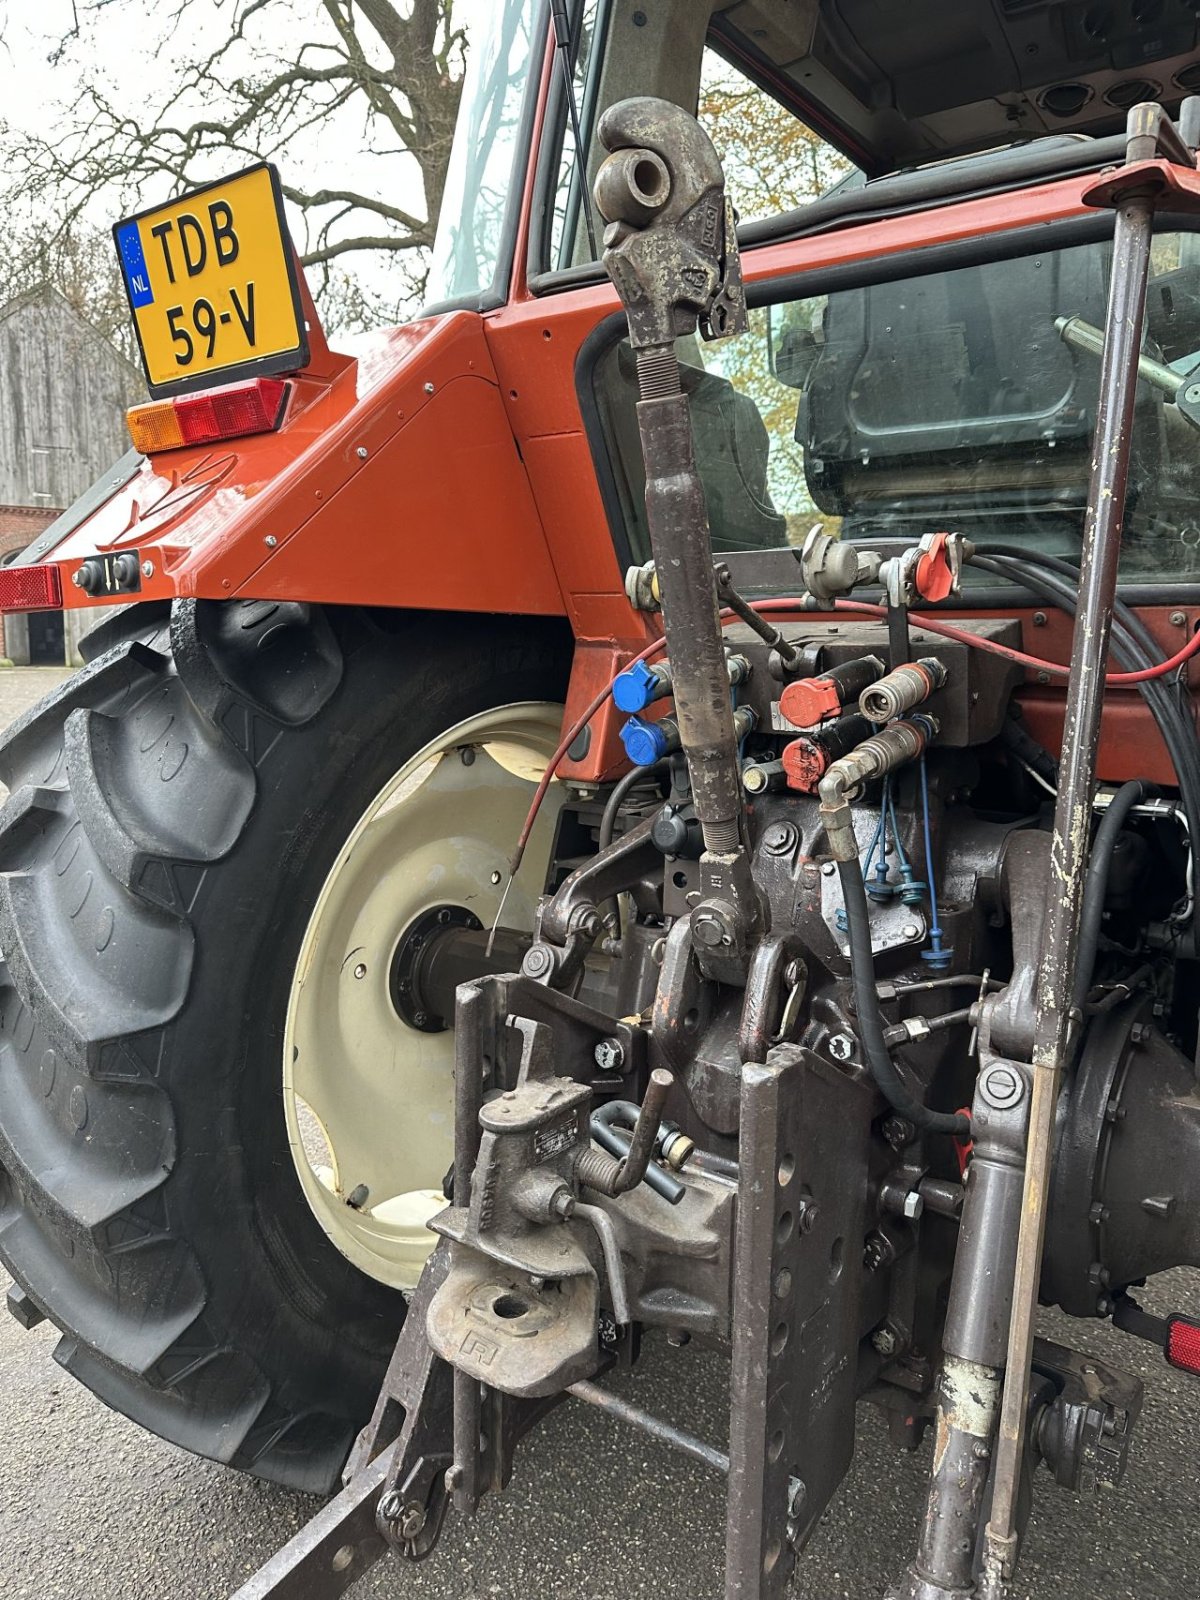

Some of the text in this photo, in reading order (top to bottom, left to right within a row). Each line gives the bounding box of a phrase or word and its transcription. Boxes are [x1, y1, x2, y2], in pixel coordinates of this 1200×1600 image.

[152, 200, 240, 284] TDB
[132, 276, 149, 294] NL
[166, 282, 256, 366] 59-V
